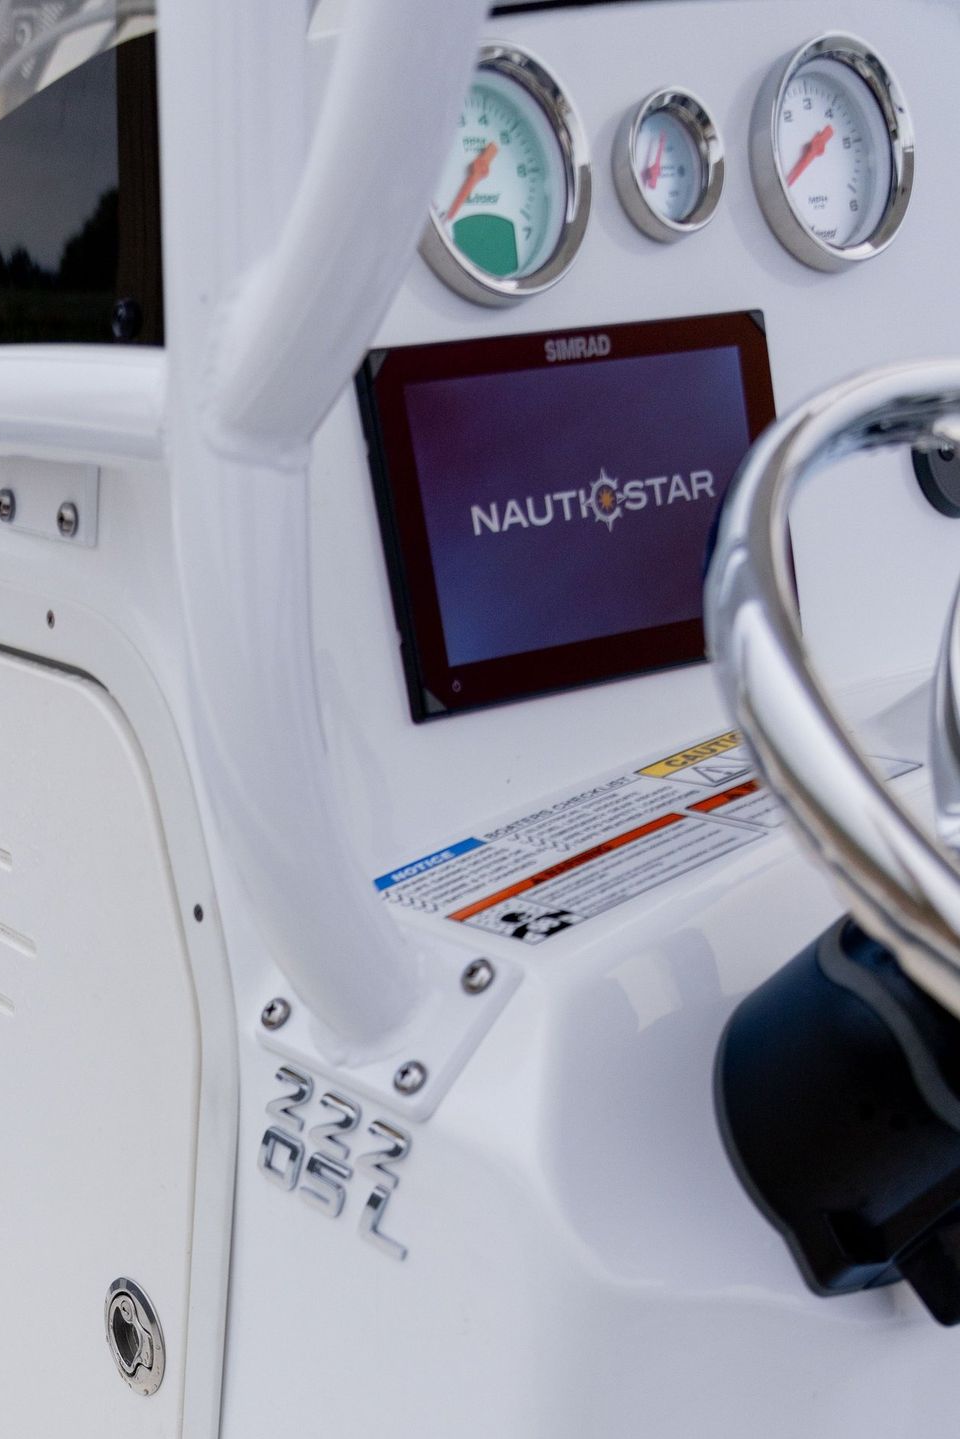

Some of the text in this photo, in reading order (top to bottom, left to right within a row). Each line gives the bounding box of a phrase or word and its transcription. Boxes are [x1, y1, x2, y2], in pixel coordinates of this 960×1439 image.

[544, 334, 610, 362] SIMRAD
[470, 466, 716, 537] NAUTICSTAR
[390, 849, 456, 883] NOTICE
[265, 1065, 412, 1190] 222
